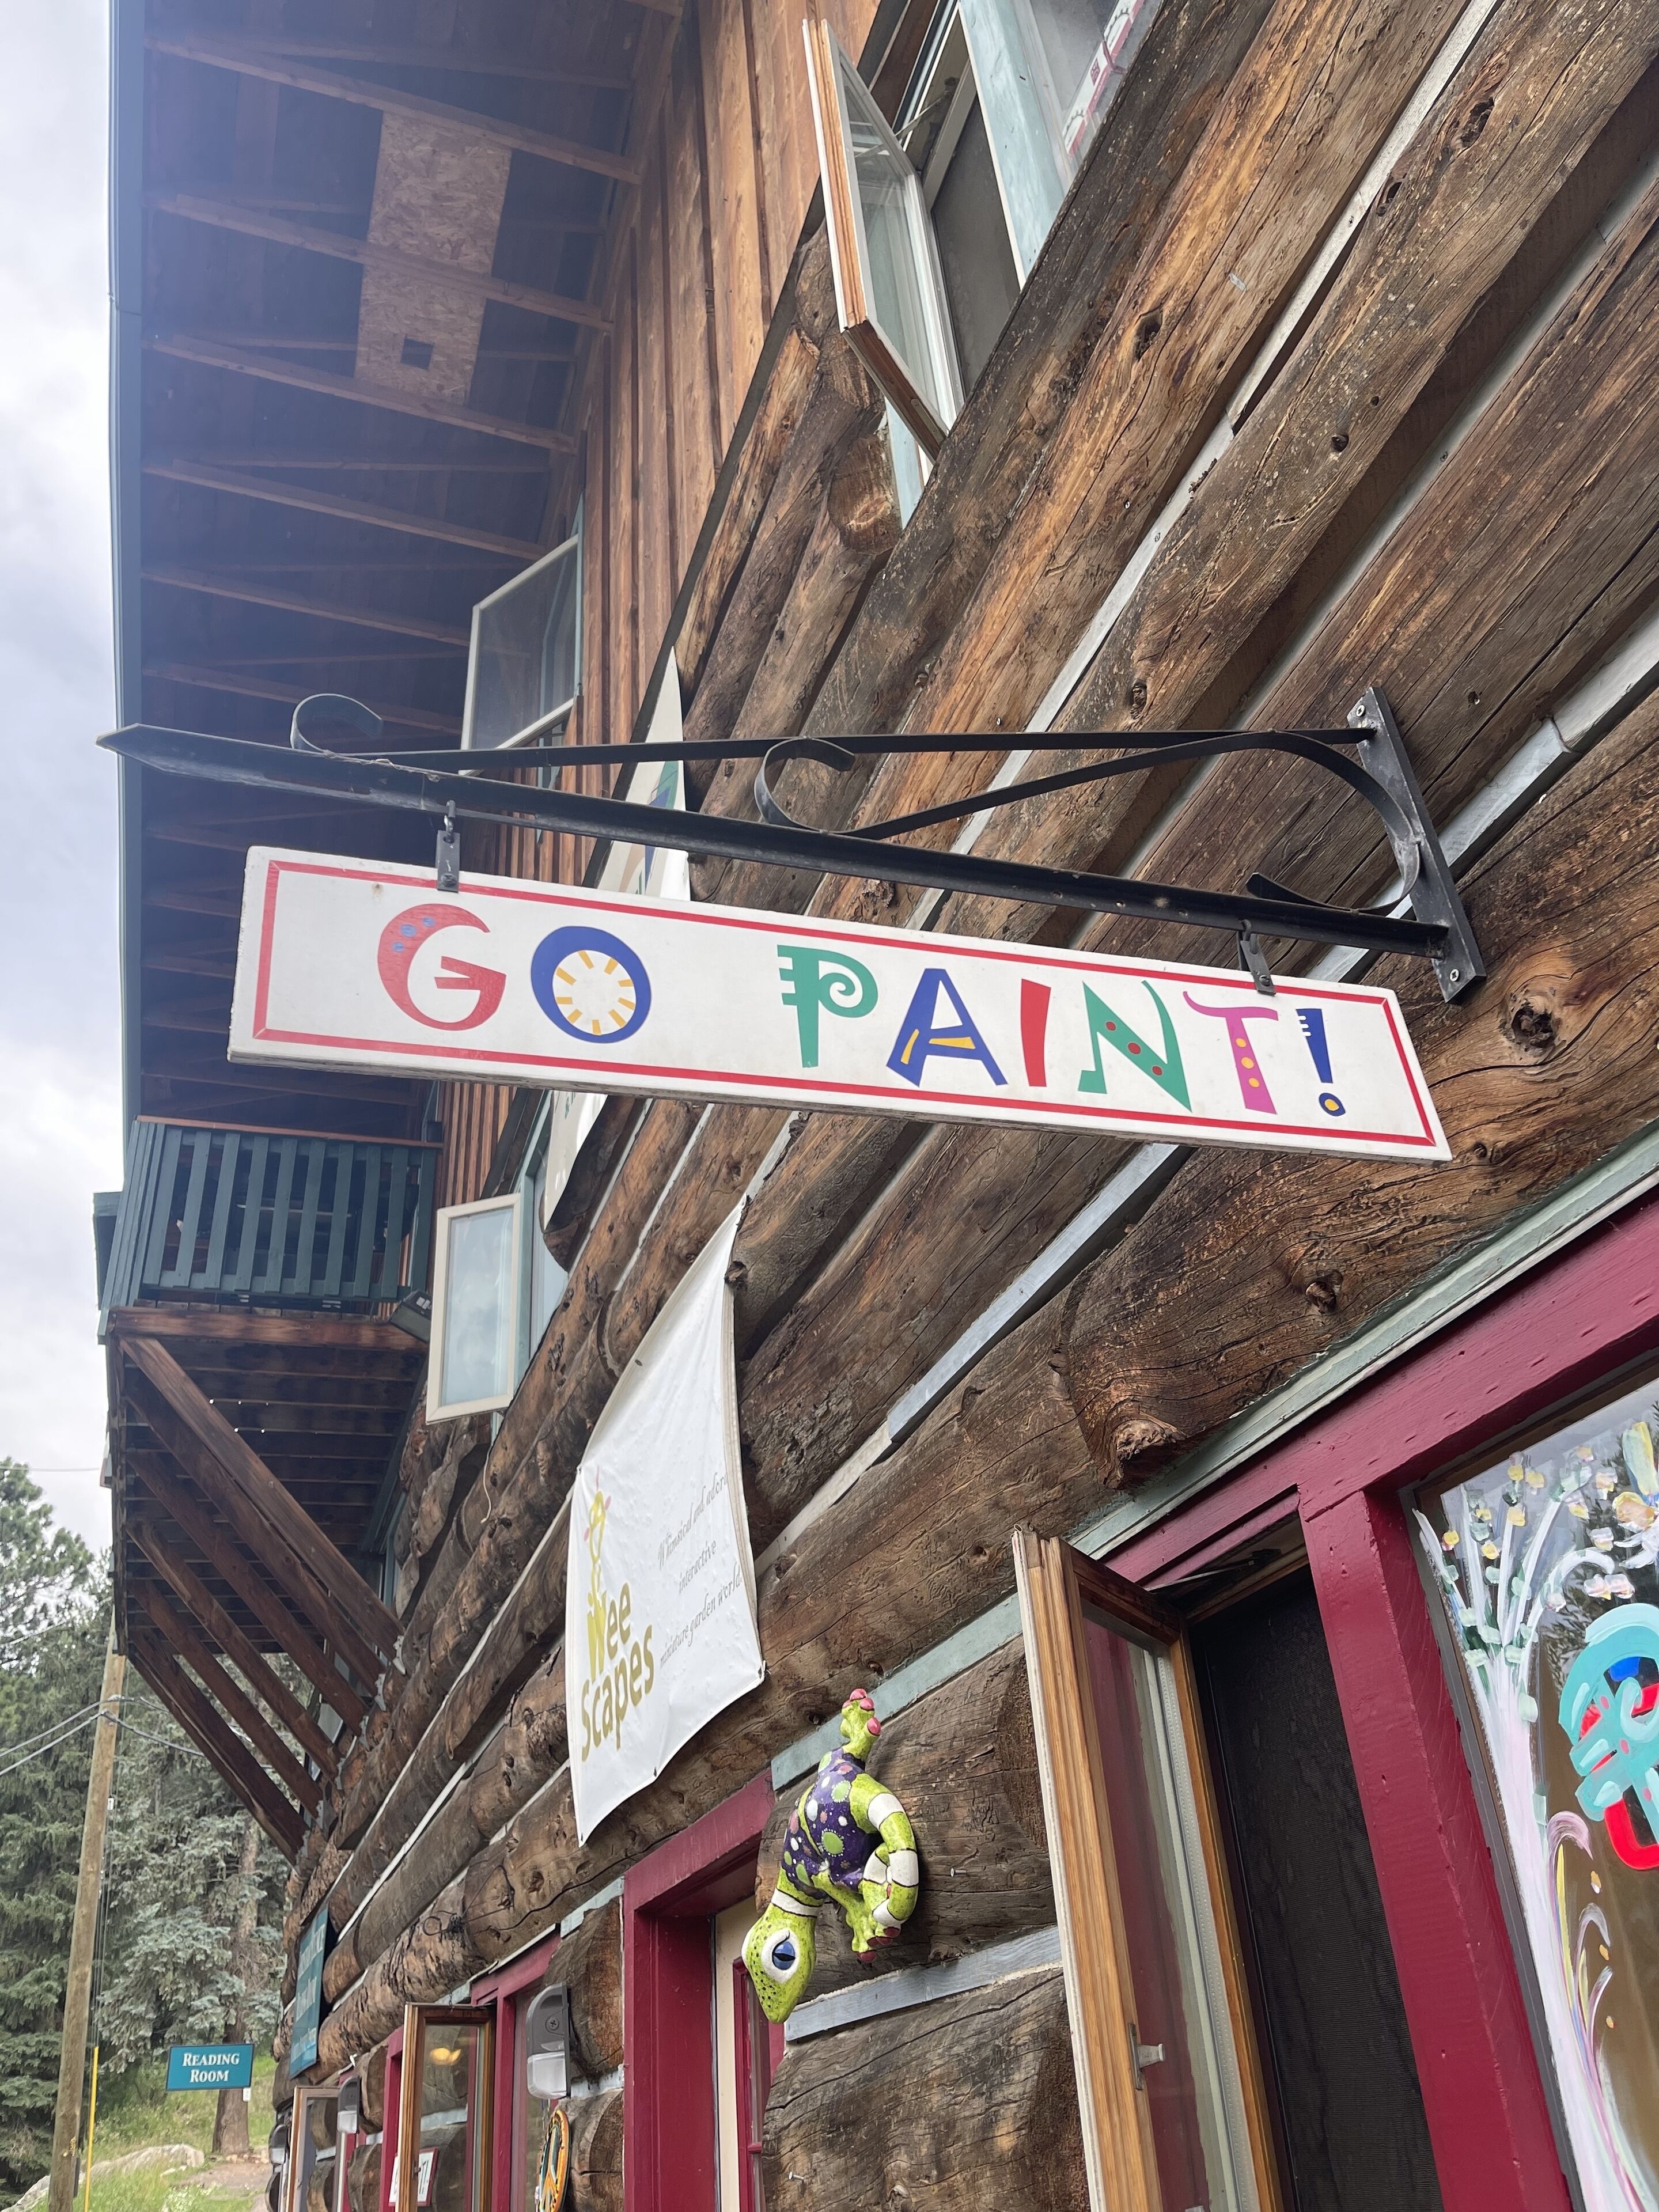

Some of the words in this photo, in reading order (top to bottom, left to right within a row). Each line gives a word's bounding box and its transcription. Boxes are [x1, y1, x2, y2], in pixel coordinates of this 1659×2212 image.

[377, 903, 652, 1043] GO
[777, 944, 1346, 1118] PAINT!
[679, 1540, 716, 1593] interactive
[587, 1582, 631, 1685] Wee
[688, 1593, 716, 1647] garden
[182, 2052, 240, 2067] READING
[190, 2069, 230, 2083] ROOM
